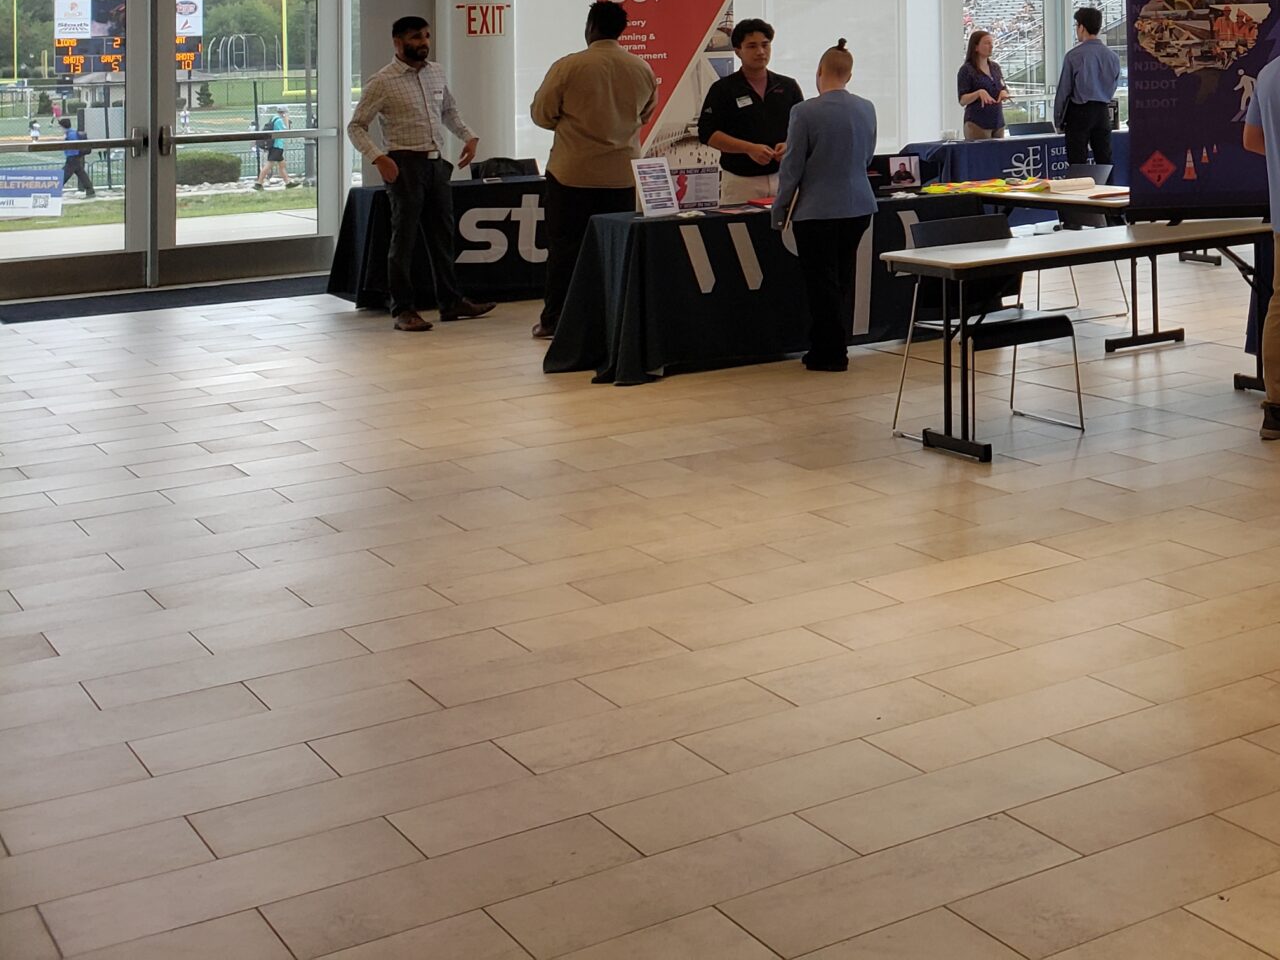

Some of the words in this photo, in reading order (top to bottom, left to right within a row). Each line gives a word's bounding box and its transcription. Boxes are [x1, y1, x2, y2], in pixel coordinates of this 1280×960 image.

[467, 5, 505, 35] EXIT
[55, 38, 77, 47] LIONS
[113, 38, 121, 48] 2
[622, 44, 646, 52] gram
[63, 56, 84, 64] SHOTS
[70, 64, 82, 74] 13
[112, 62, 120, 72] 5
[181, 61, 193, 71] 10
[0, 180, 60, 189] ELETHERAPY
[455, 193, 549, 263] st
